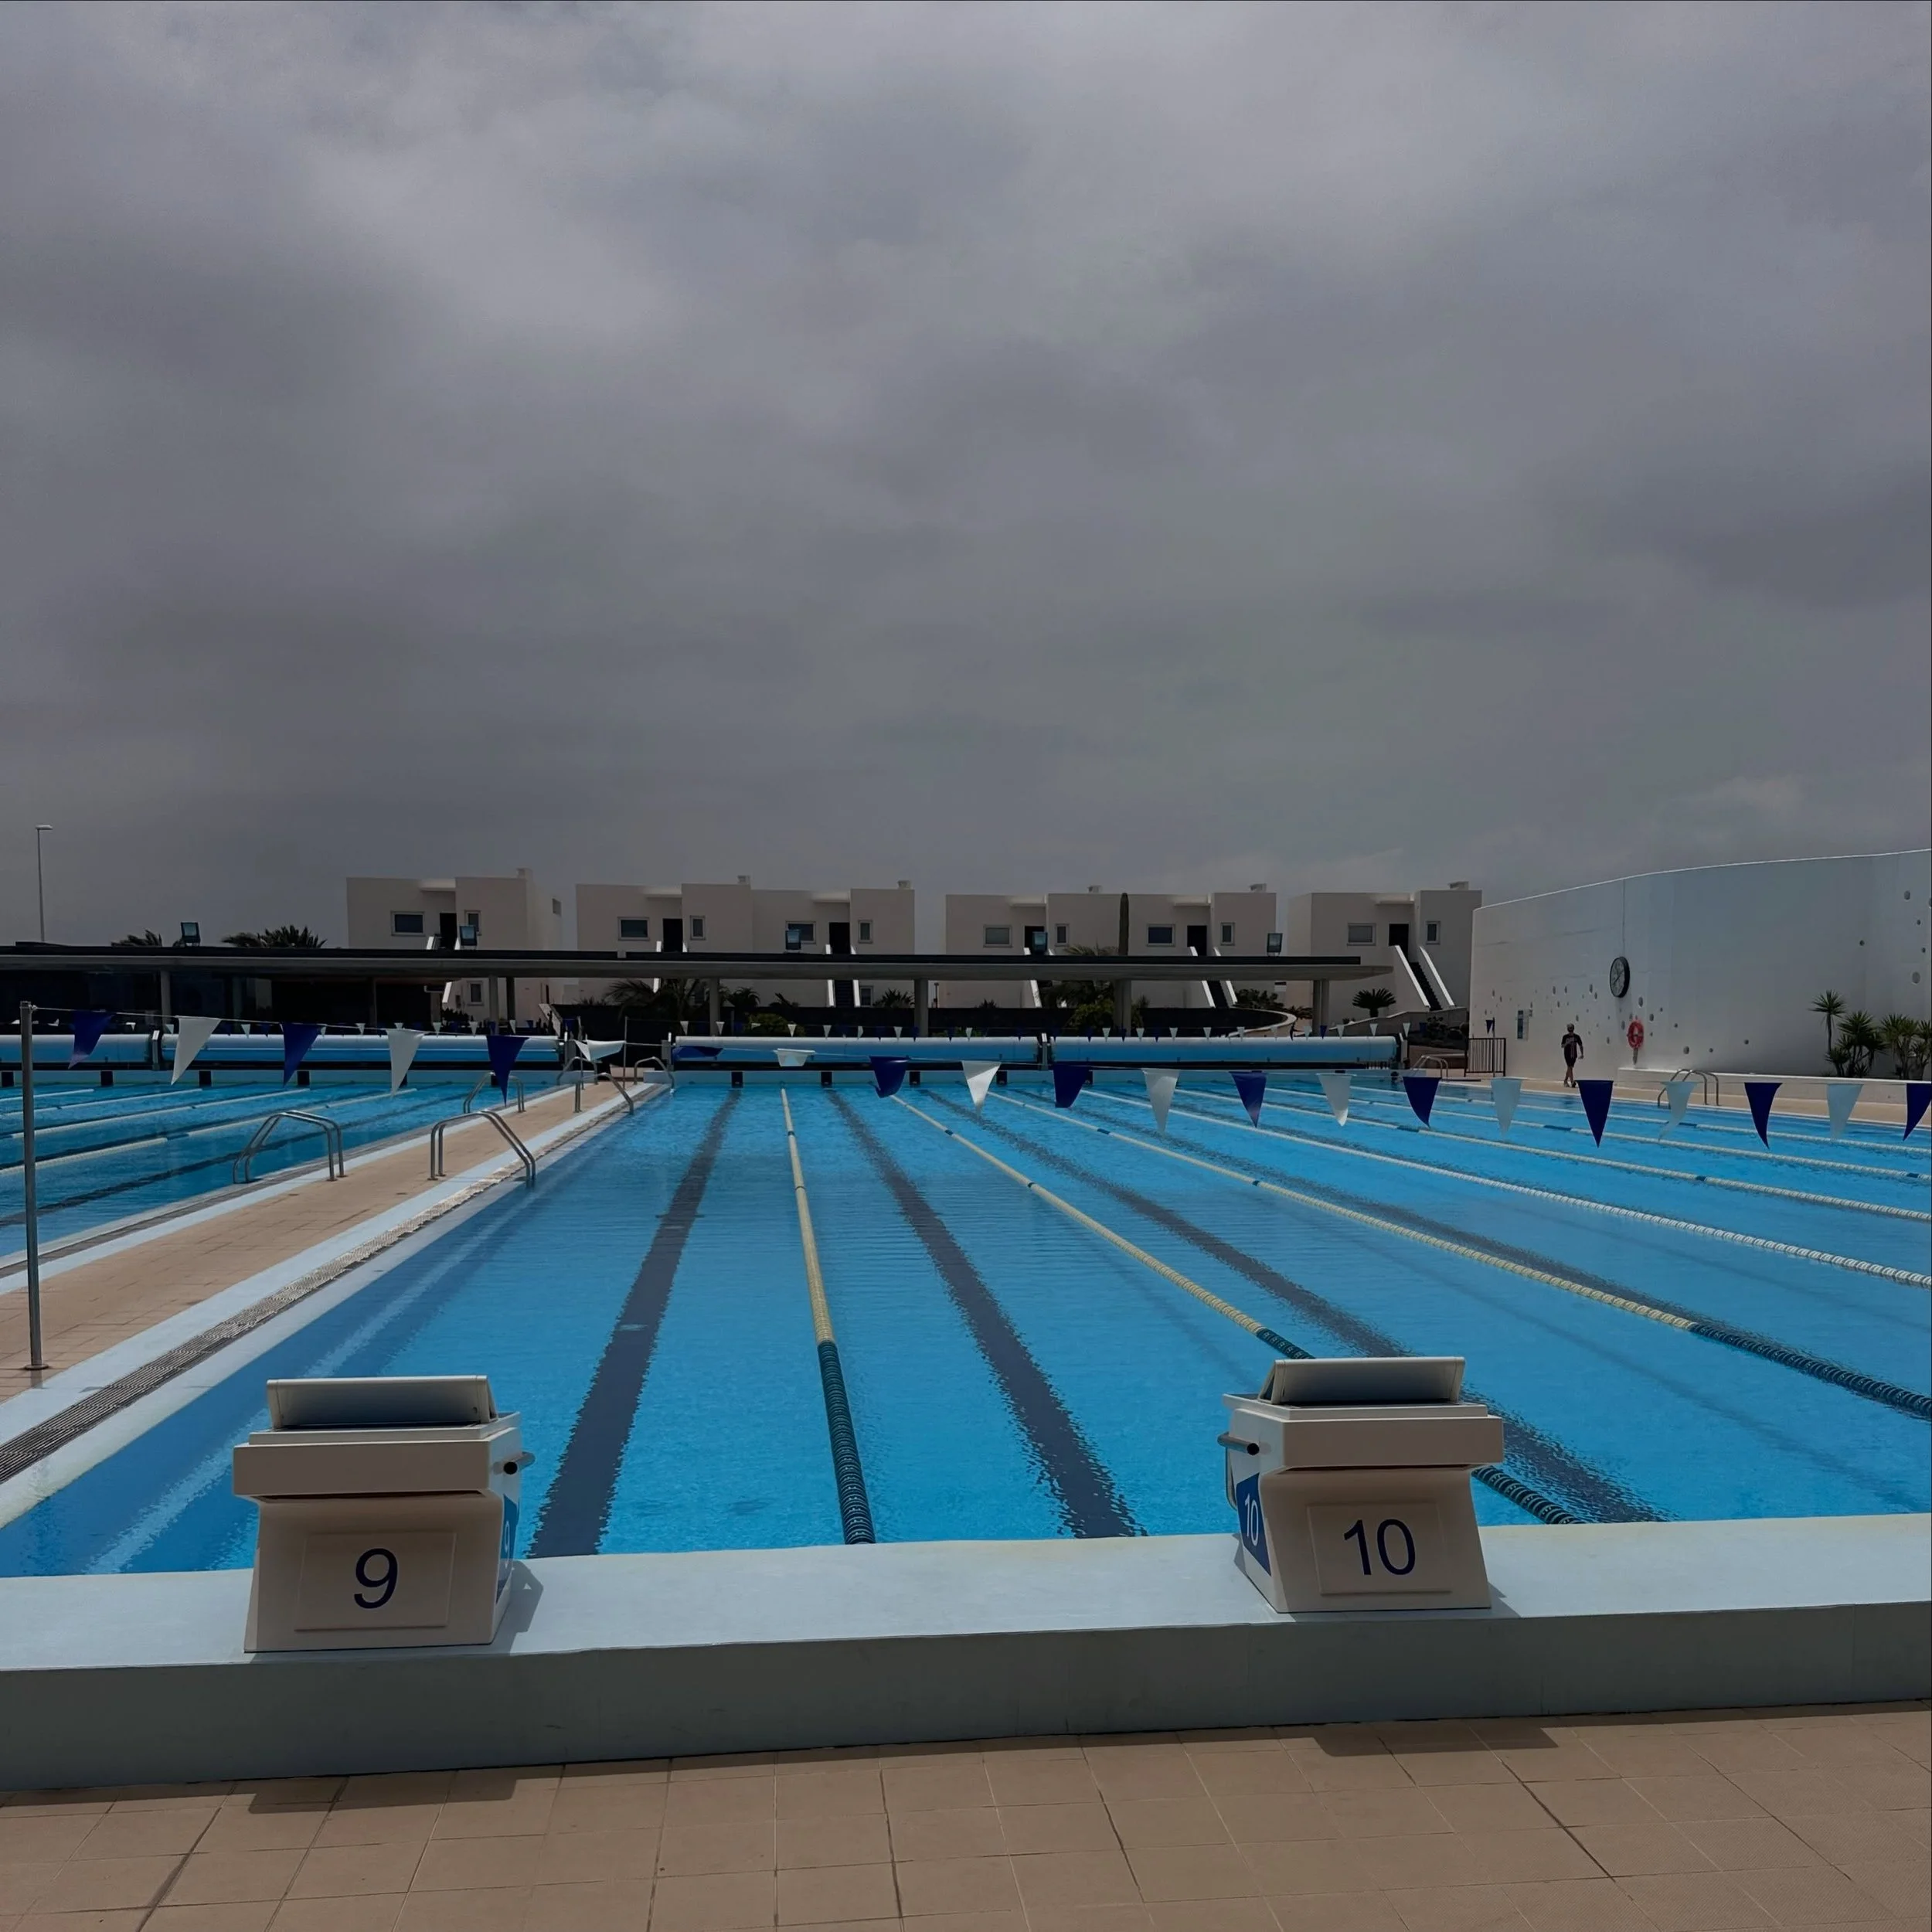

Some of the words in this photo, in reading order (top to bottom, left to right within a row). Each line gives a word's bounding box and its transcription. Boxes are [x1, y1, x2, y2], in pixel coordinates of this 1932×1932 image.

[1244, 1493, 1259, 1546] 10
[1343, 1519, 1416, 1576] 10
[353, 1548, 398, 1609] 9
